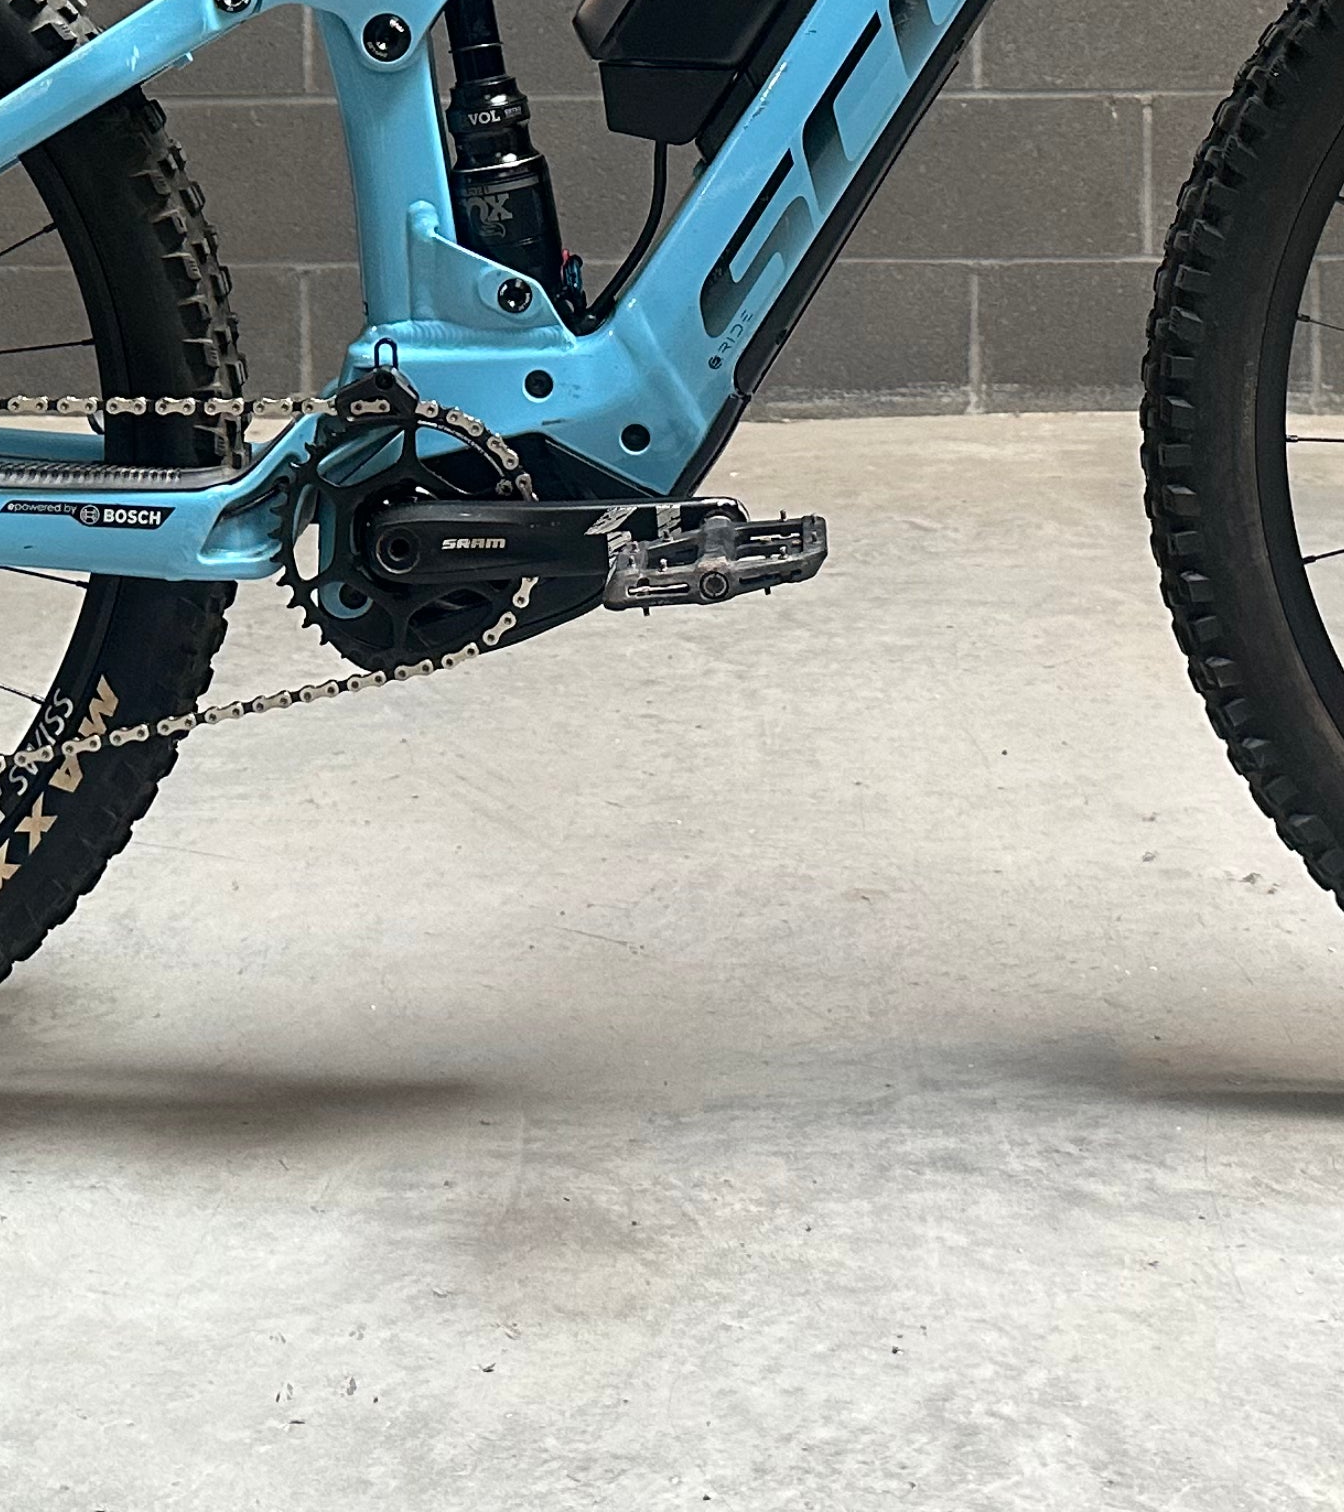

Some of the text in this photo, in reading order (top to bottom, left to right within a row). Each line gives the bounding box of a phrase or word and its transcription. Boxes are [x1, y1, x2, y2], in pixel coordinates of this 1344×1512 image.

[467, 109, 502, 126] VOL
[63, 503, 78, 515] by
[103, 508, 162, 526] BOSCH
[441, 537, 506, 551] SRAM
